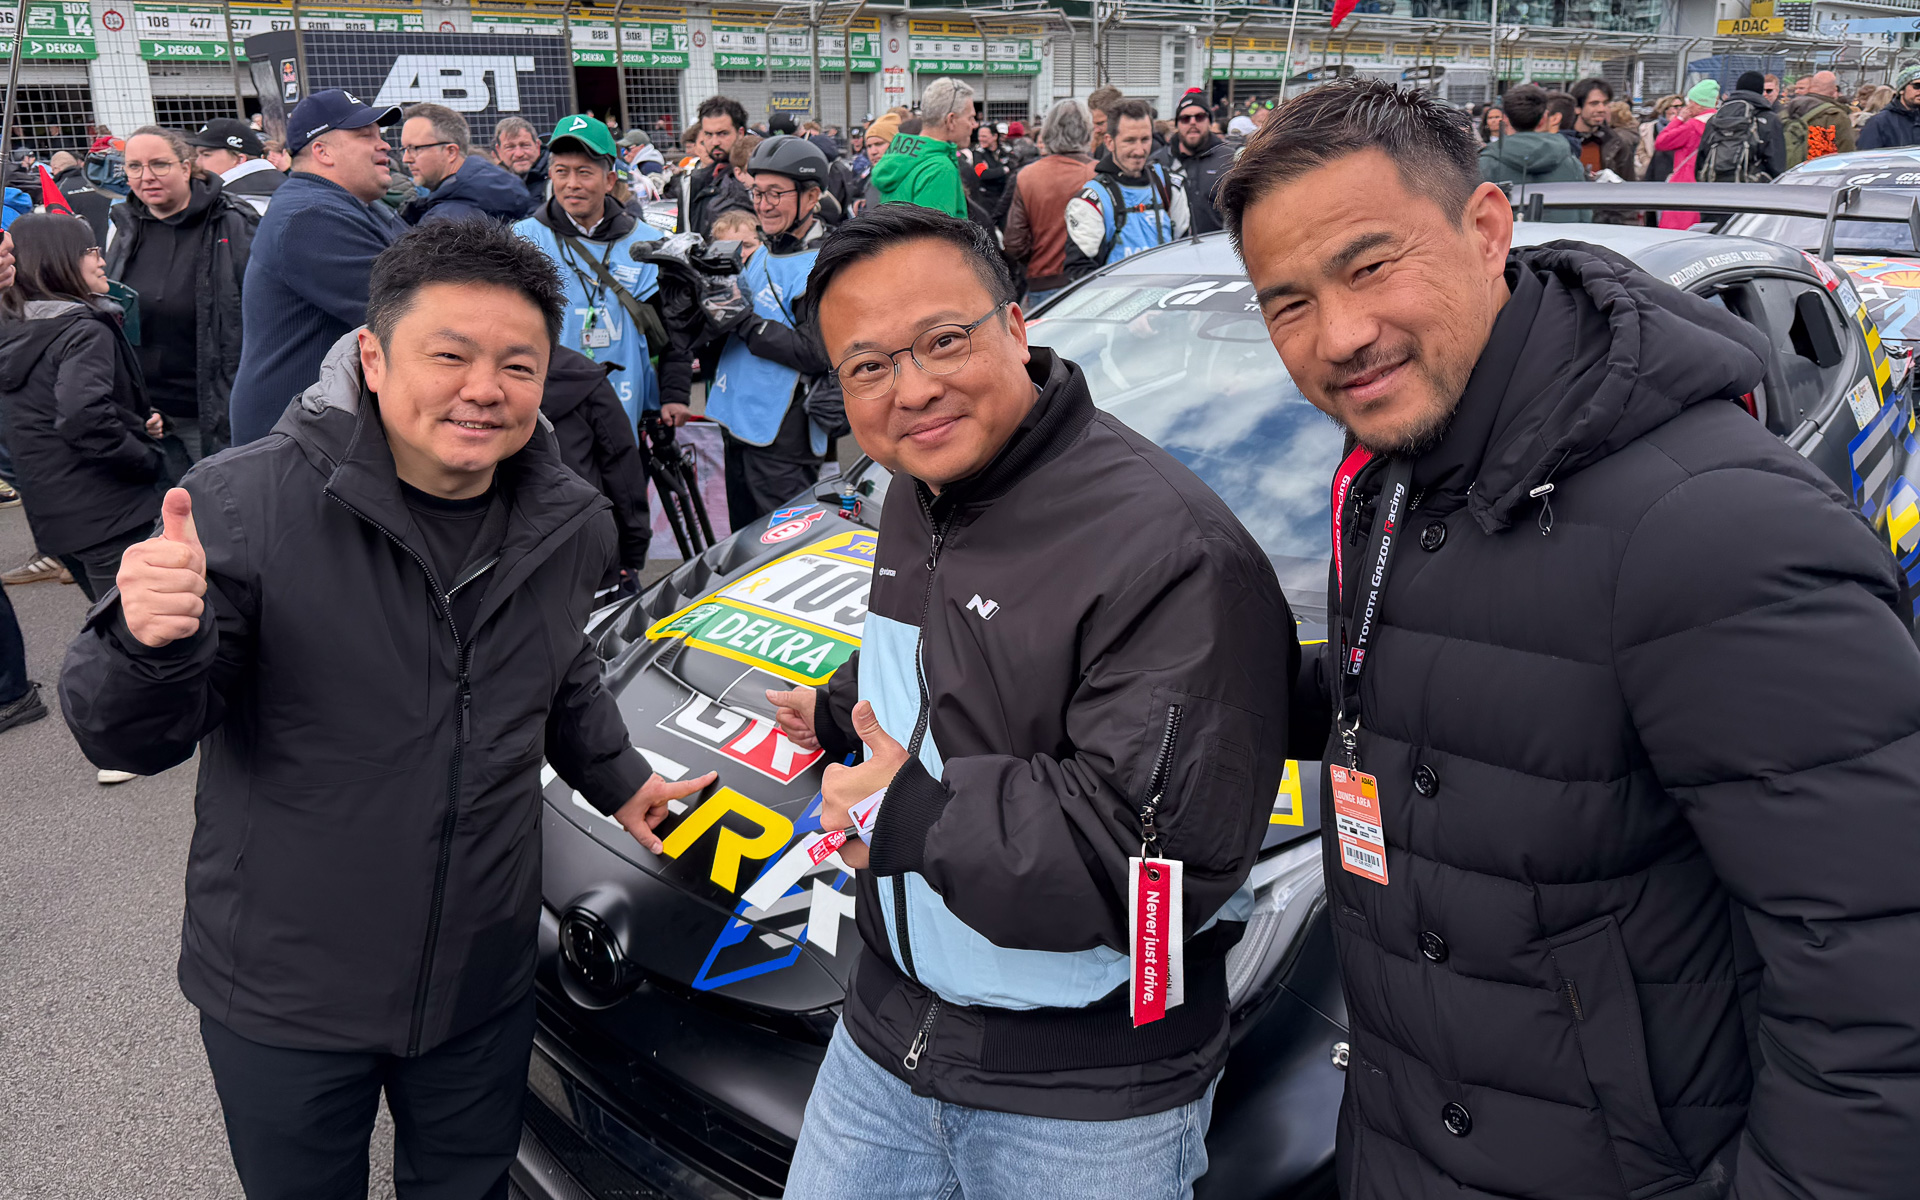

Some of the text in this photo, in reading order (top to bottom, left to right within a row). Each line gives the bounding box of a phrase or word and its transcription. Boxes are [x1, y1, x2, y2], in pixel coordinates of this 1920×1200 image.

[62, 2, 90, 14] BOX
[64, 15, 93, 36] 14
[147, 16, 169, 28] 108
[190, 17, 212, 29] 477
[231, 18, 252, 30] 577
[402, 15, 424, 25] BOX
[1732, 19, 1769, 33] ADAC
[45, 43, 85, 54] DEKRA
[168, 44, 203, 56] DEKRA
[672, 34, 689, 51] 12
[372, 54, 535, 112] ABT
[1358, 590, 1379, 645] TOYOTA
[1371, 535, 1391, 587] GAZOO
[1384, 482, 1405, 534] Racing
[705, 612, 835, 674] DEKRA
[1335, 789, 1372, 808] LOUNGE AREA
[1142, 890, 1160, 1005] Never just drive.
